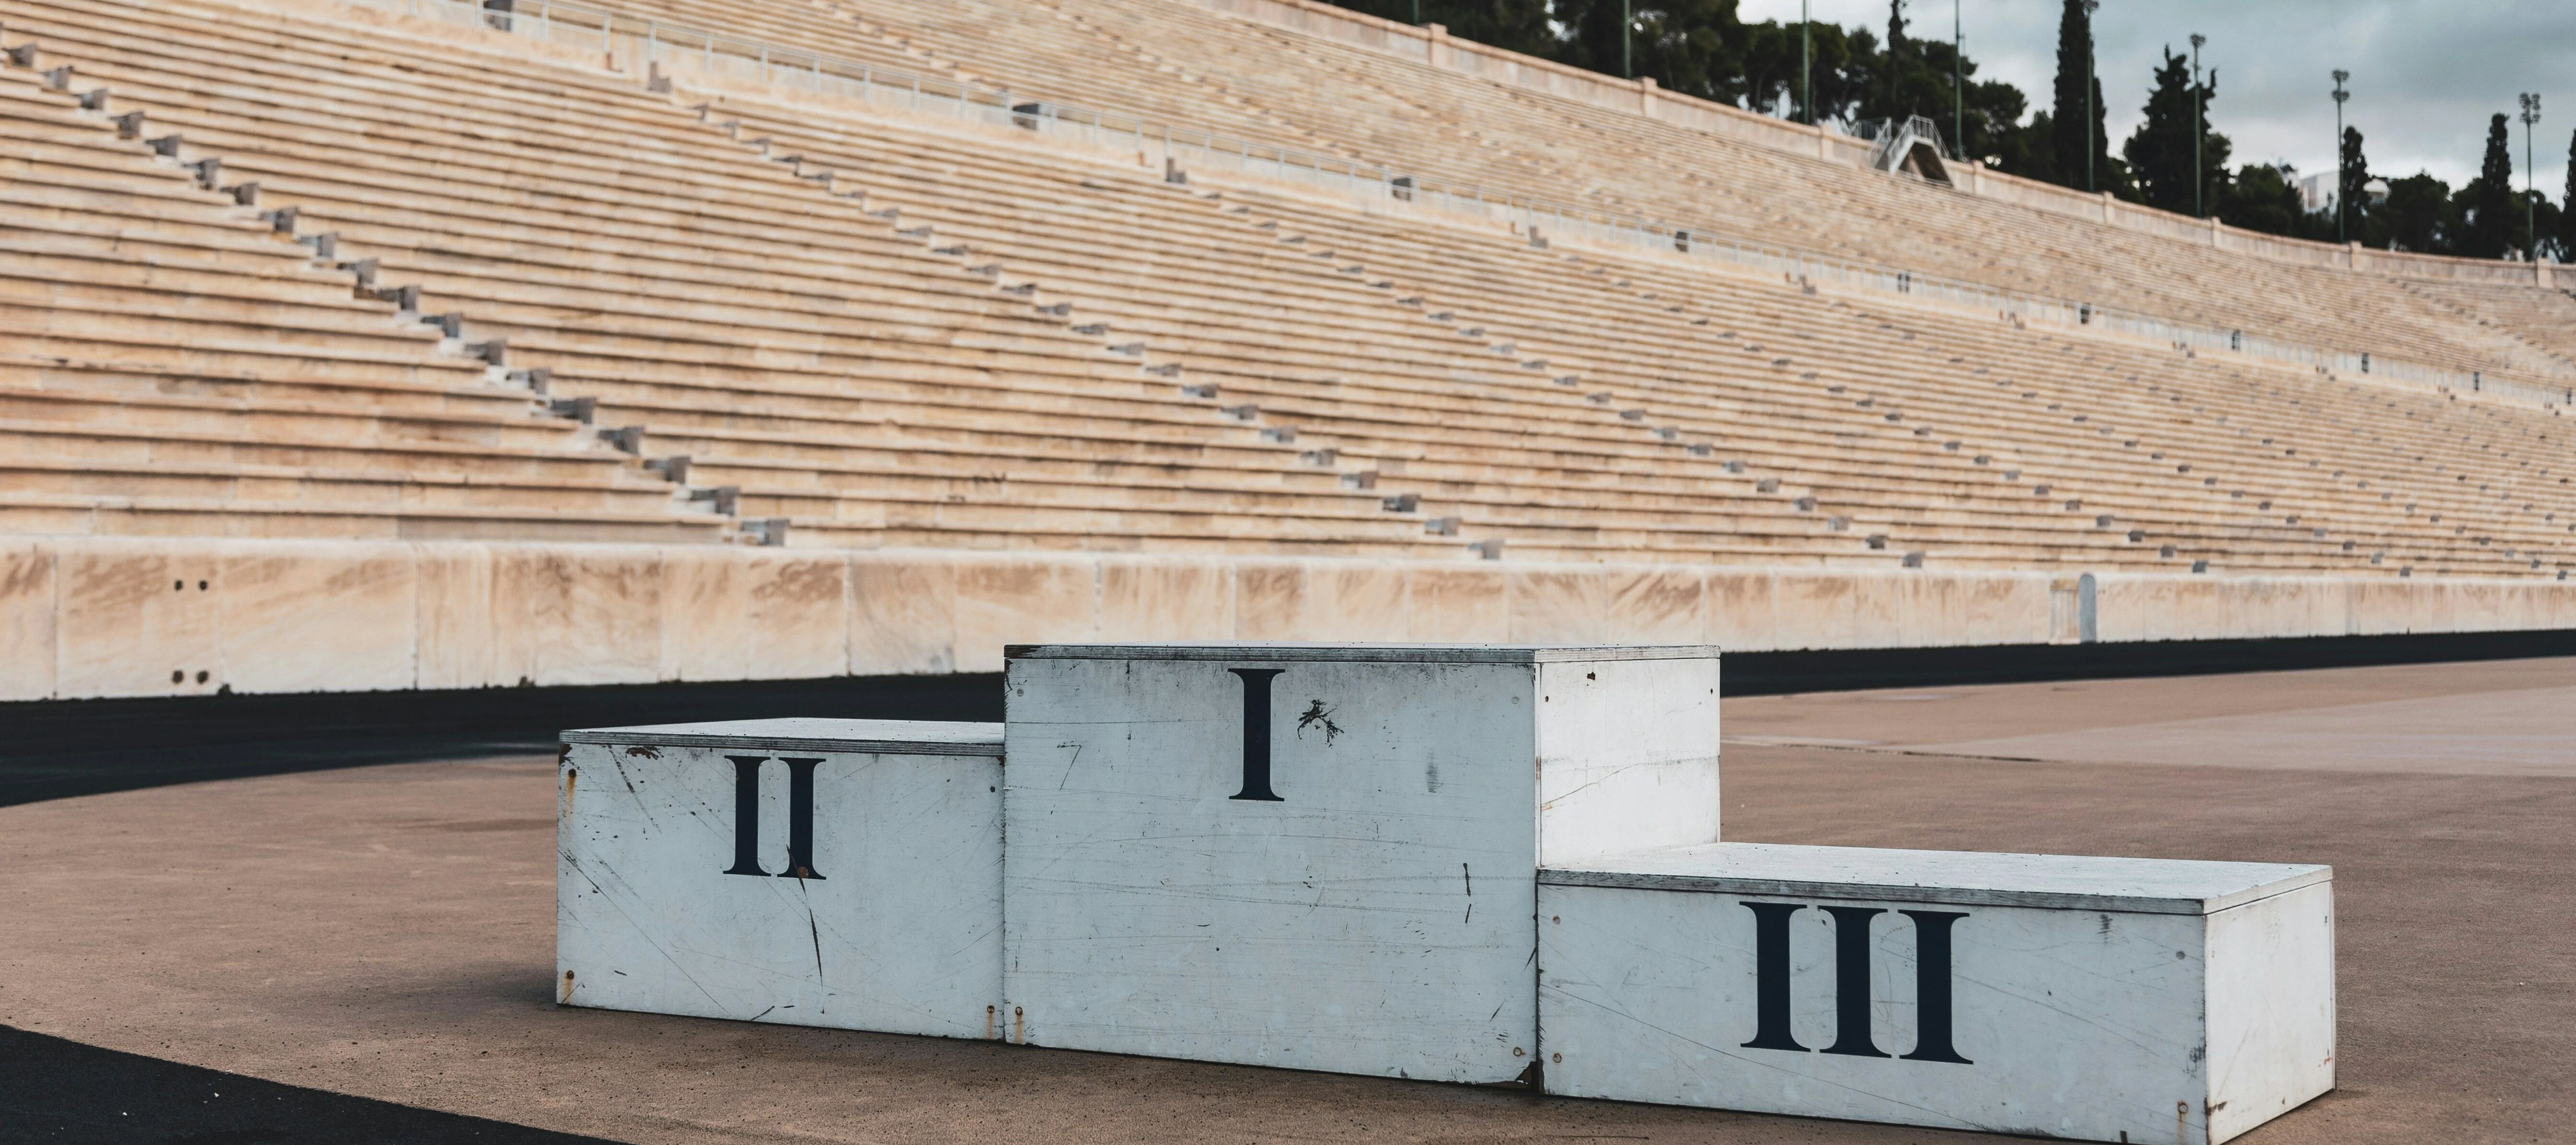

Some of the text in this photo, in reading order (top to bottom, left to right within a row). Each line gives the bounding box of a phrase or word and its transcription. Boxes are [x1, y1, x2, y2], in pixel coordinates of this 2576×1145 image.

[1227, 668, 1286, 802] I
[723, 755, 827, 880] II
[1739, 901, 1974, 1065] III
